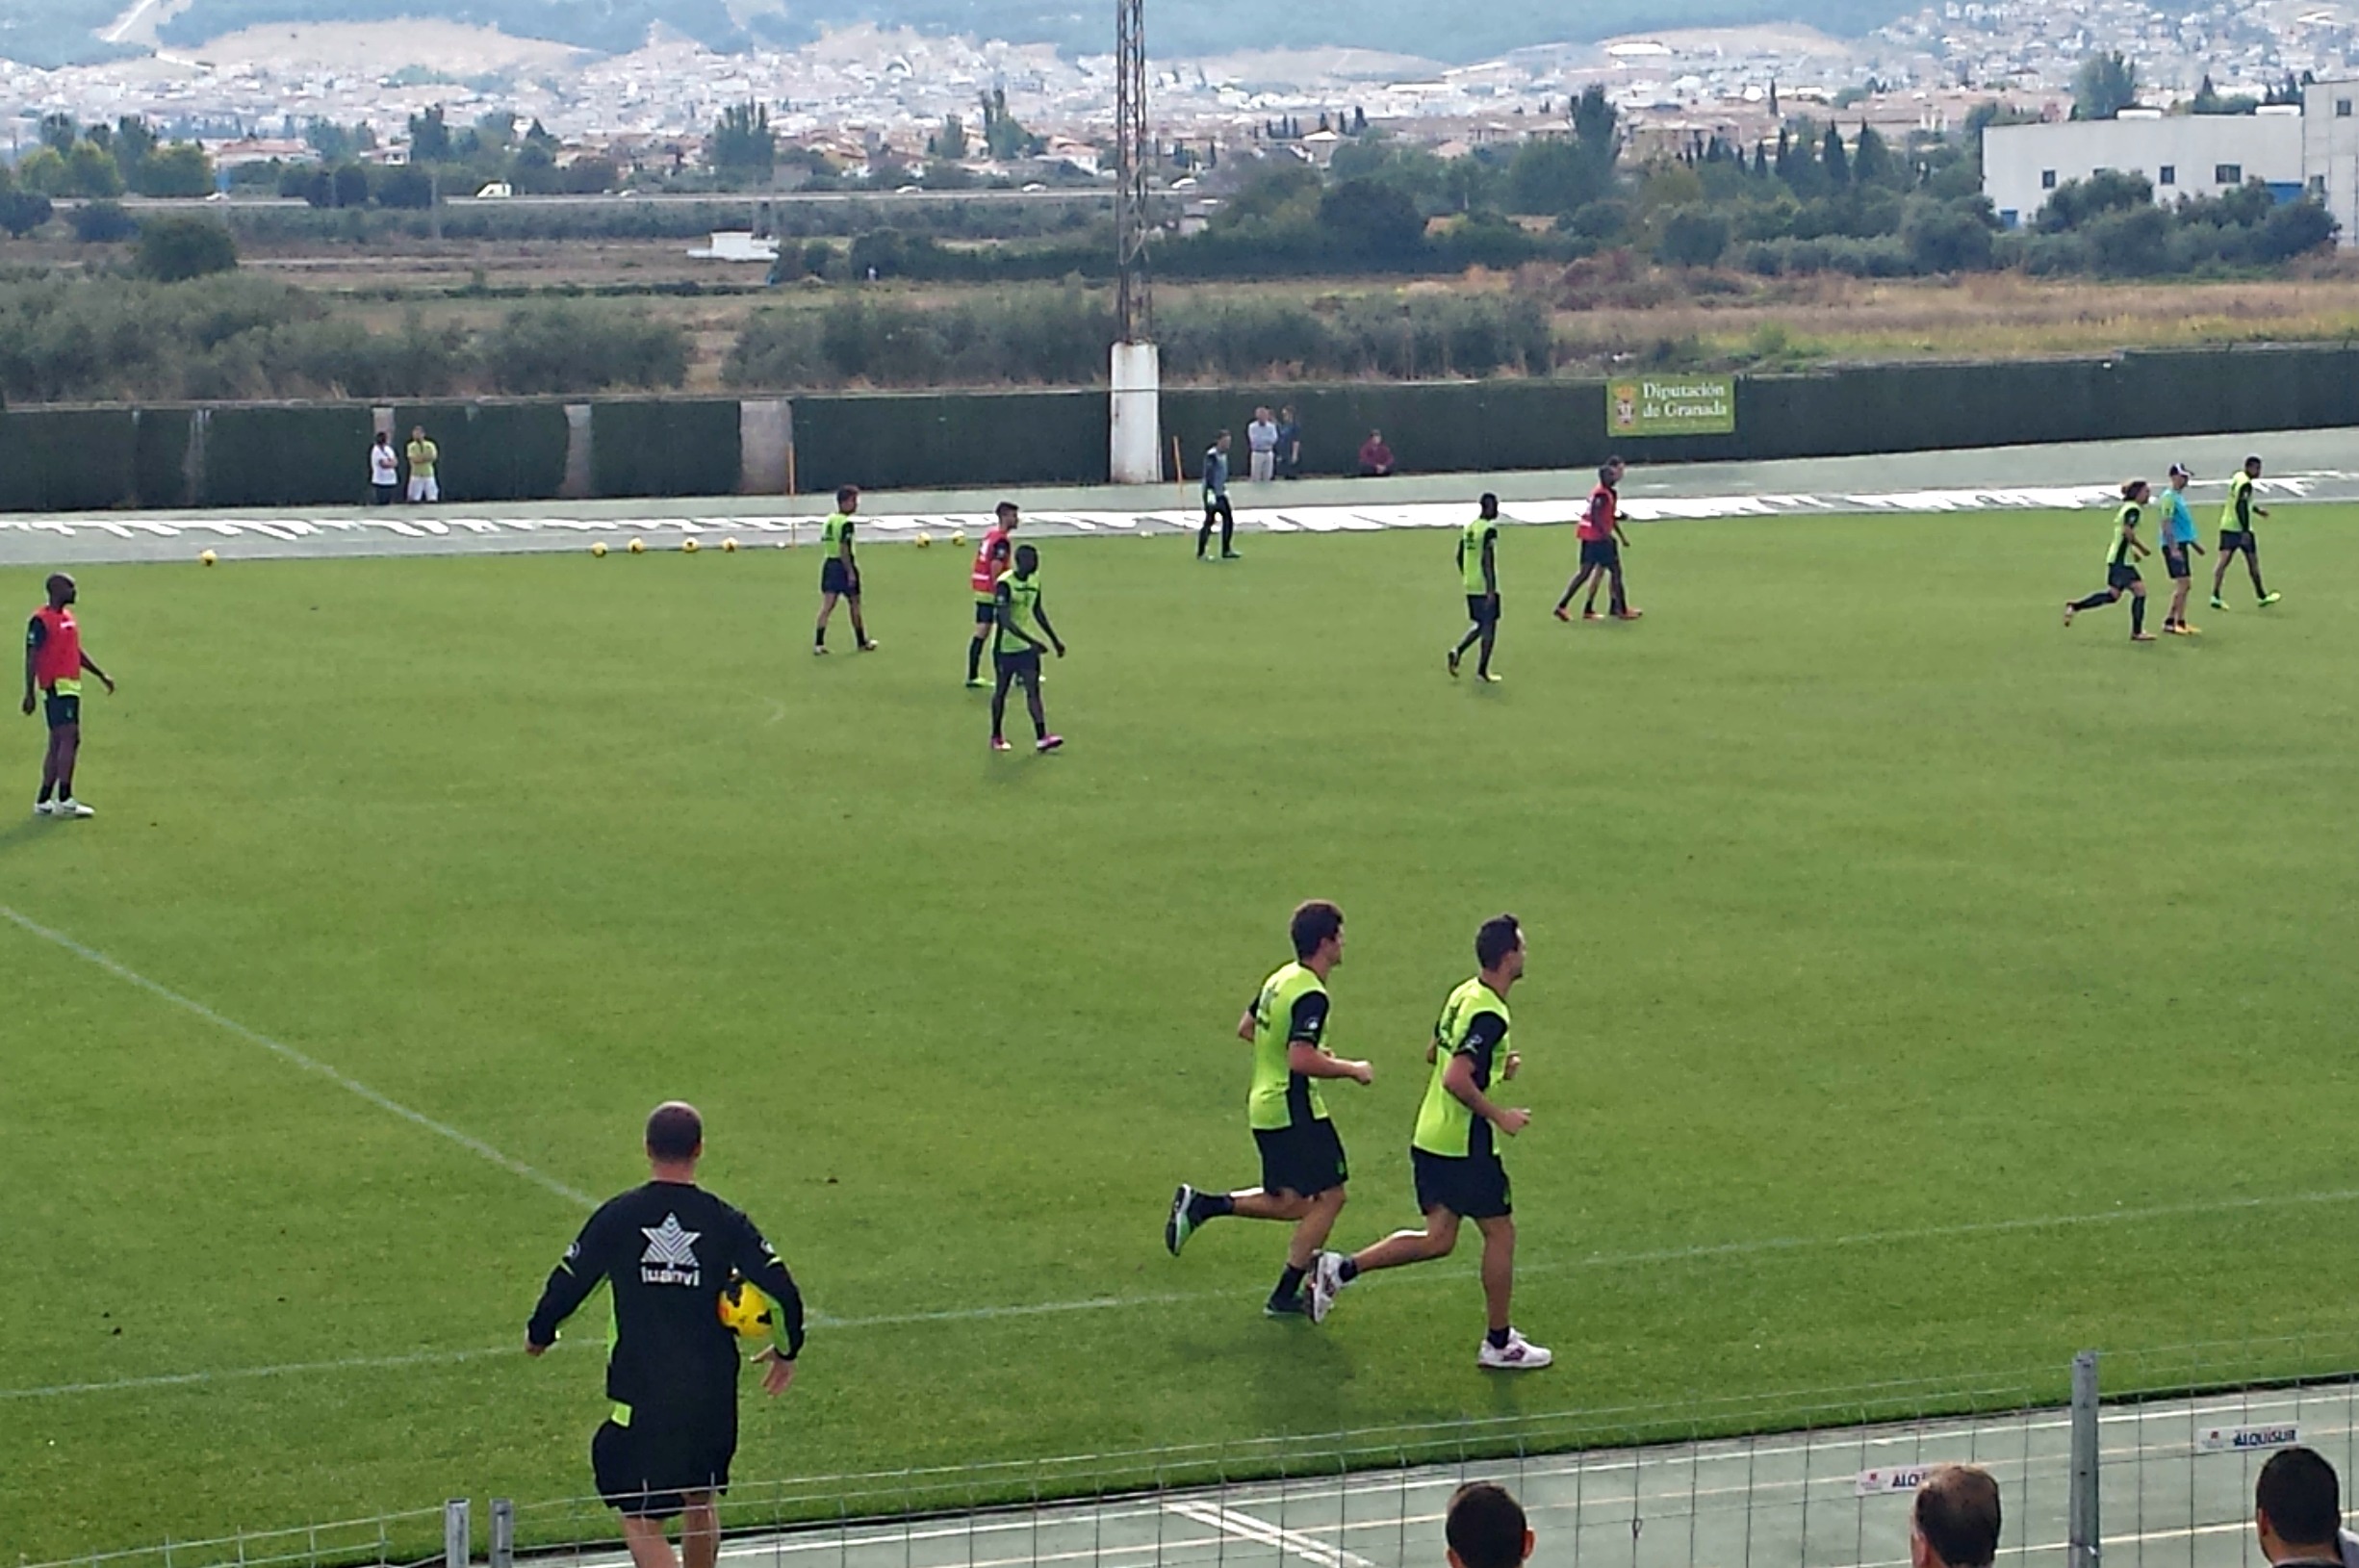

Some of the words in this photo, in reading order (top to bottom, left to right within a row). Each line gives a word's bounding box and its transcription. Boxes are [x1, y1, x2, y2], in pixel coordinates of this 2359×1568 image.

[1643, 382, 1725, 399] Diputación
[1643, 402, 1661, 417] de
[1664, 400, 1728, 417] Granada
